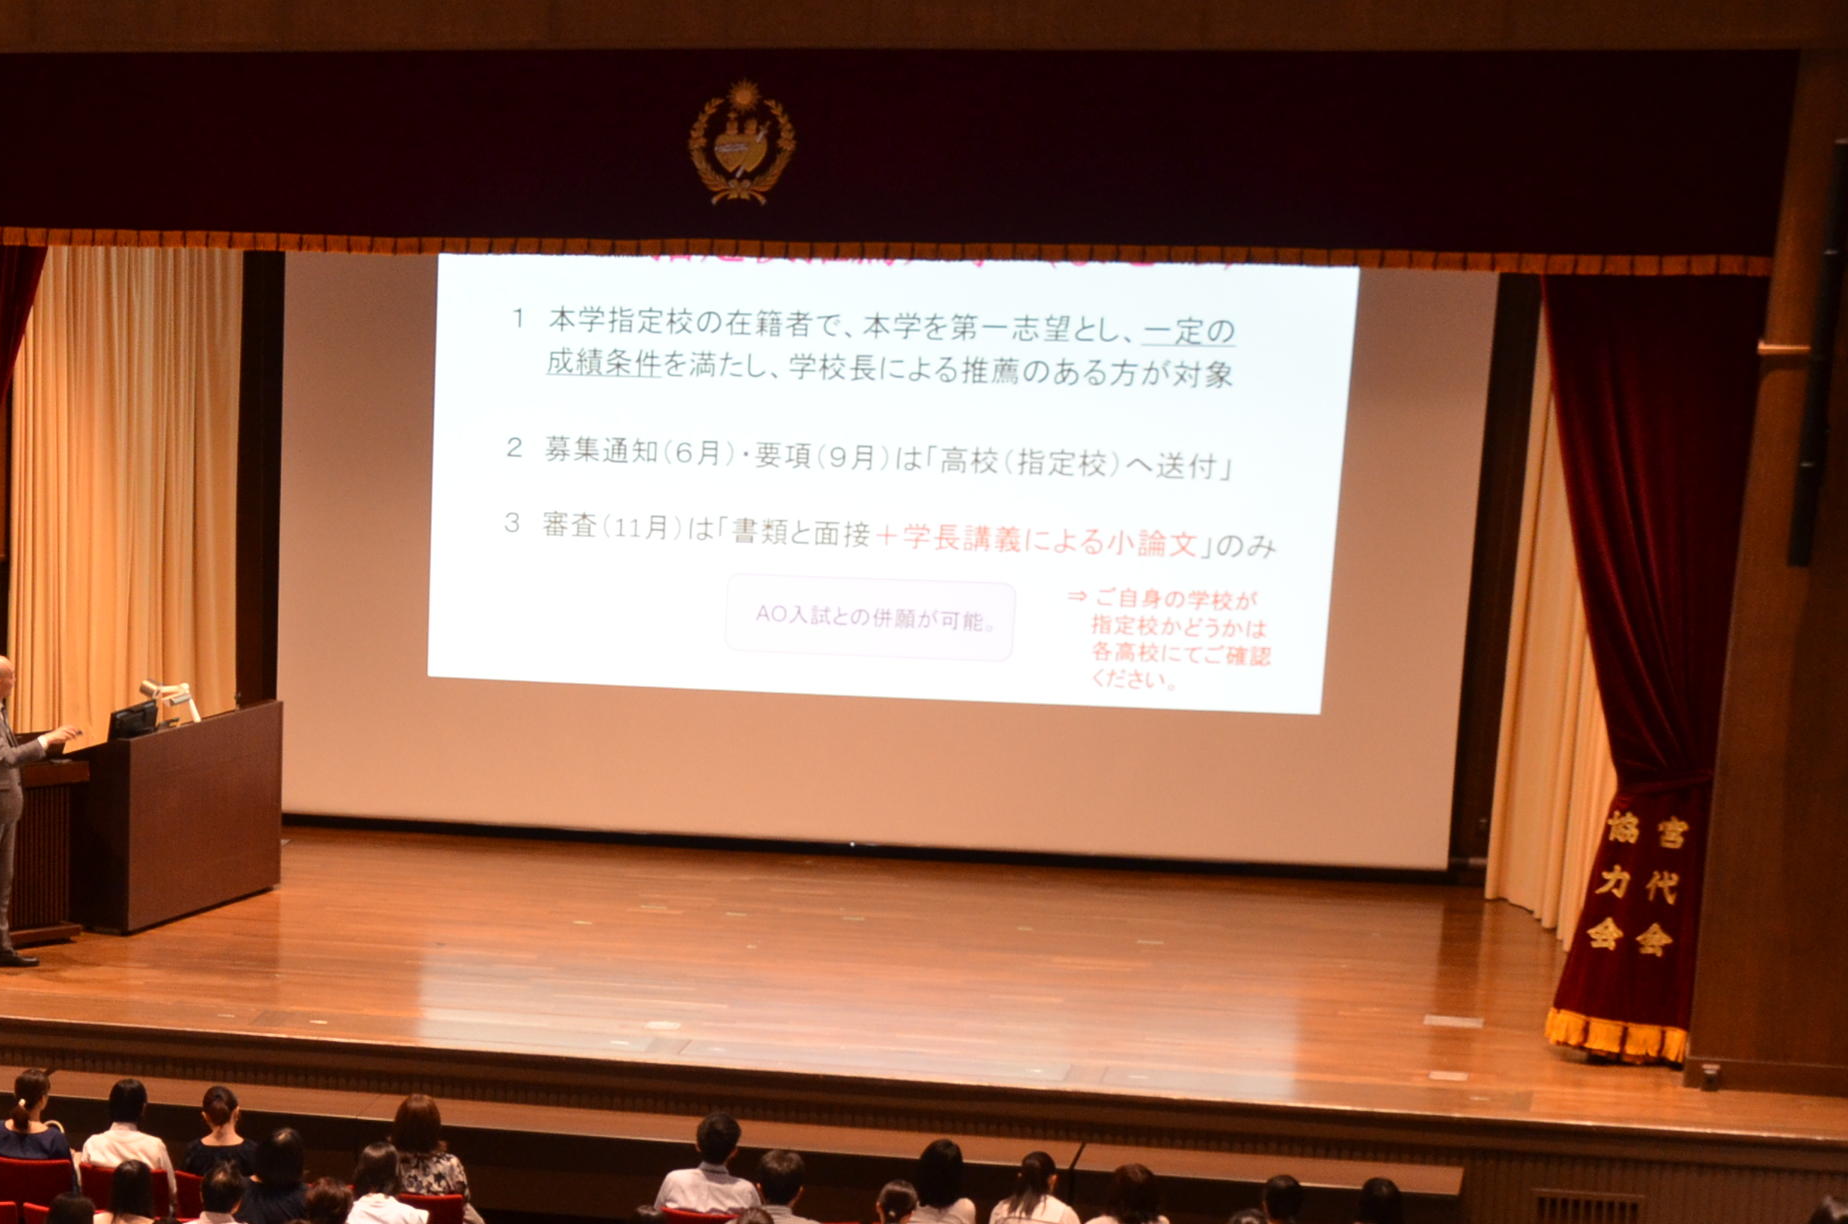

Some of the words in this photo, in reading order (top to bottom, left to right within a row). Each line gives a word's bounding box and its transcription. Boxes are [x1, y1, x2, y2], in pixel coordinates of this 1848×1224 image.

[512, 306, 523, 329] 1
[548, 305, 1237, 345] 本学指定校の在籍者で、本学を第一志望とし、一定の
[545, 346, 1235, 389] 成績条件を満たし、学校長による推薦のある方が対象
[506, 437, 523, 459] 2
[504, 511, 521, 534] 3
[1096, 586, 1259, 611] ご自身の学校が
[755, 603, 994, 633] AO入試との併願が可能。
[1090, 613, 1267, 639] 指定校かどうかは
[1092, 641, 1272, 667] 各高校にてご確認
[1092, 668, 1176, 691] ください。
